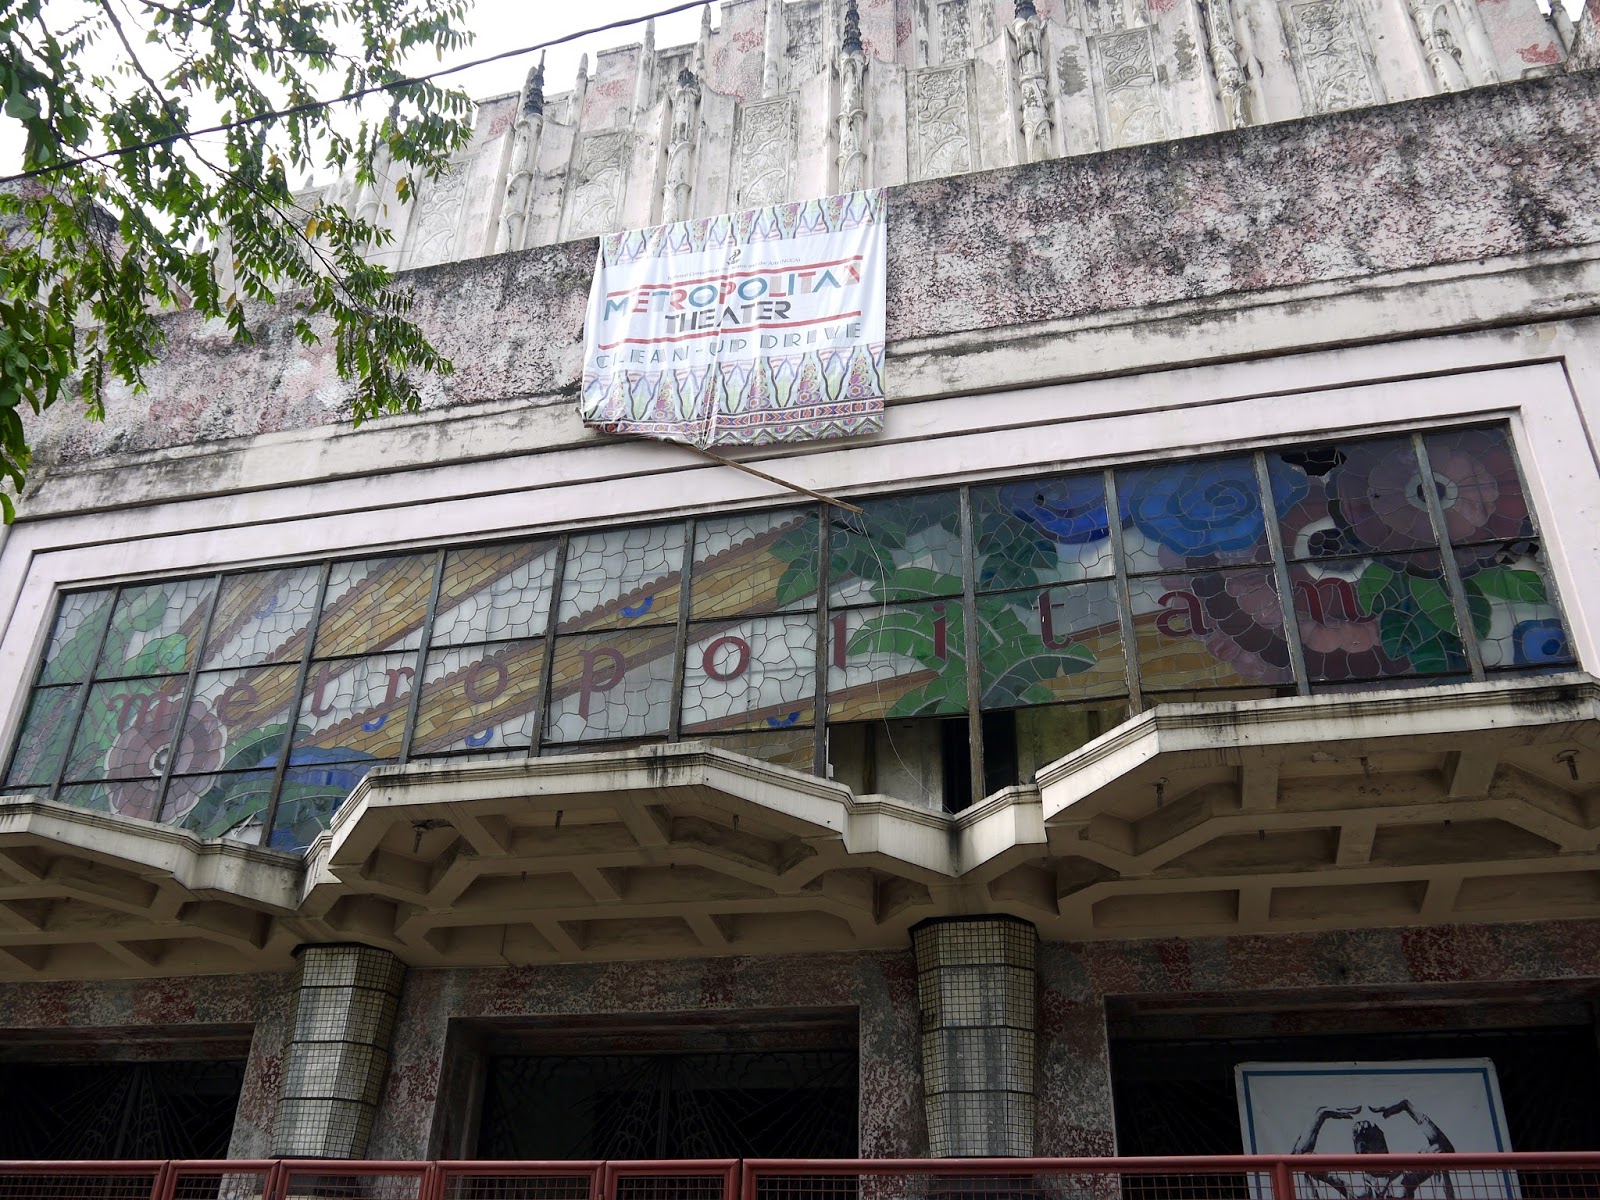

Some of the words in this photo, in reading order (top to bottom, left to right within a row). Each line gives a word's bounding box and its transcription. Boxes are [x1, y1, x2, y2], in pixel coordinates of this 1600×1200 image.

[604, 263, 860, 321] METROPOLITAN
[665, 301, 791, 334] THEATER
[596, 338, 747, 369] CLEAN-UP
[760, 322, 861, 349] DRIVE
